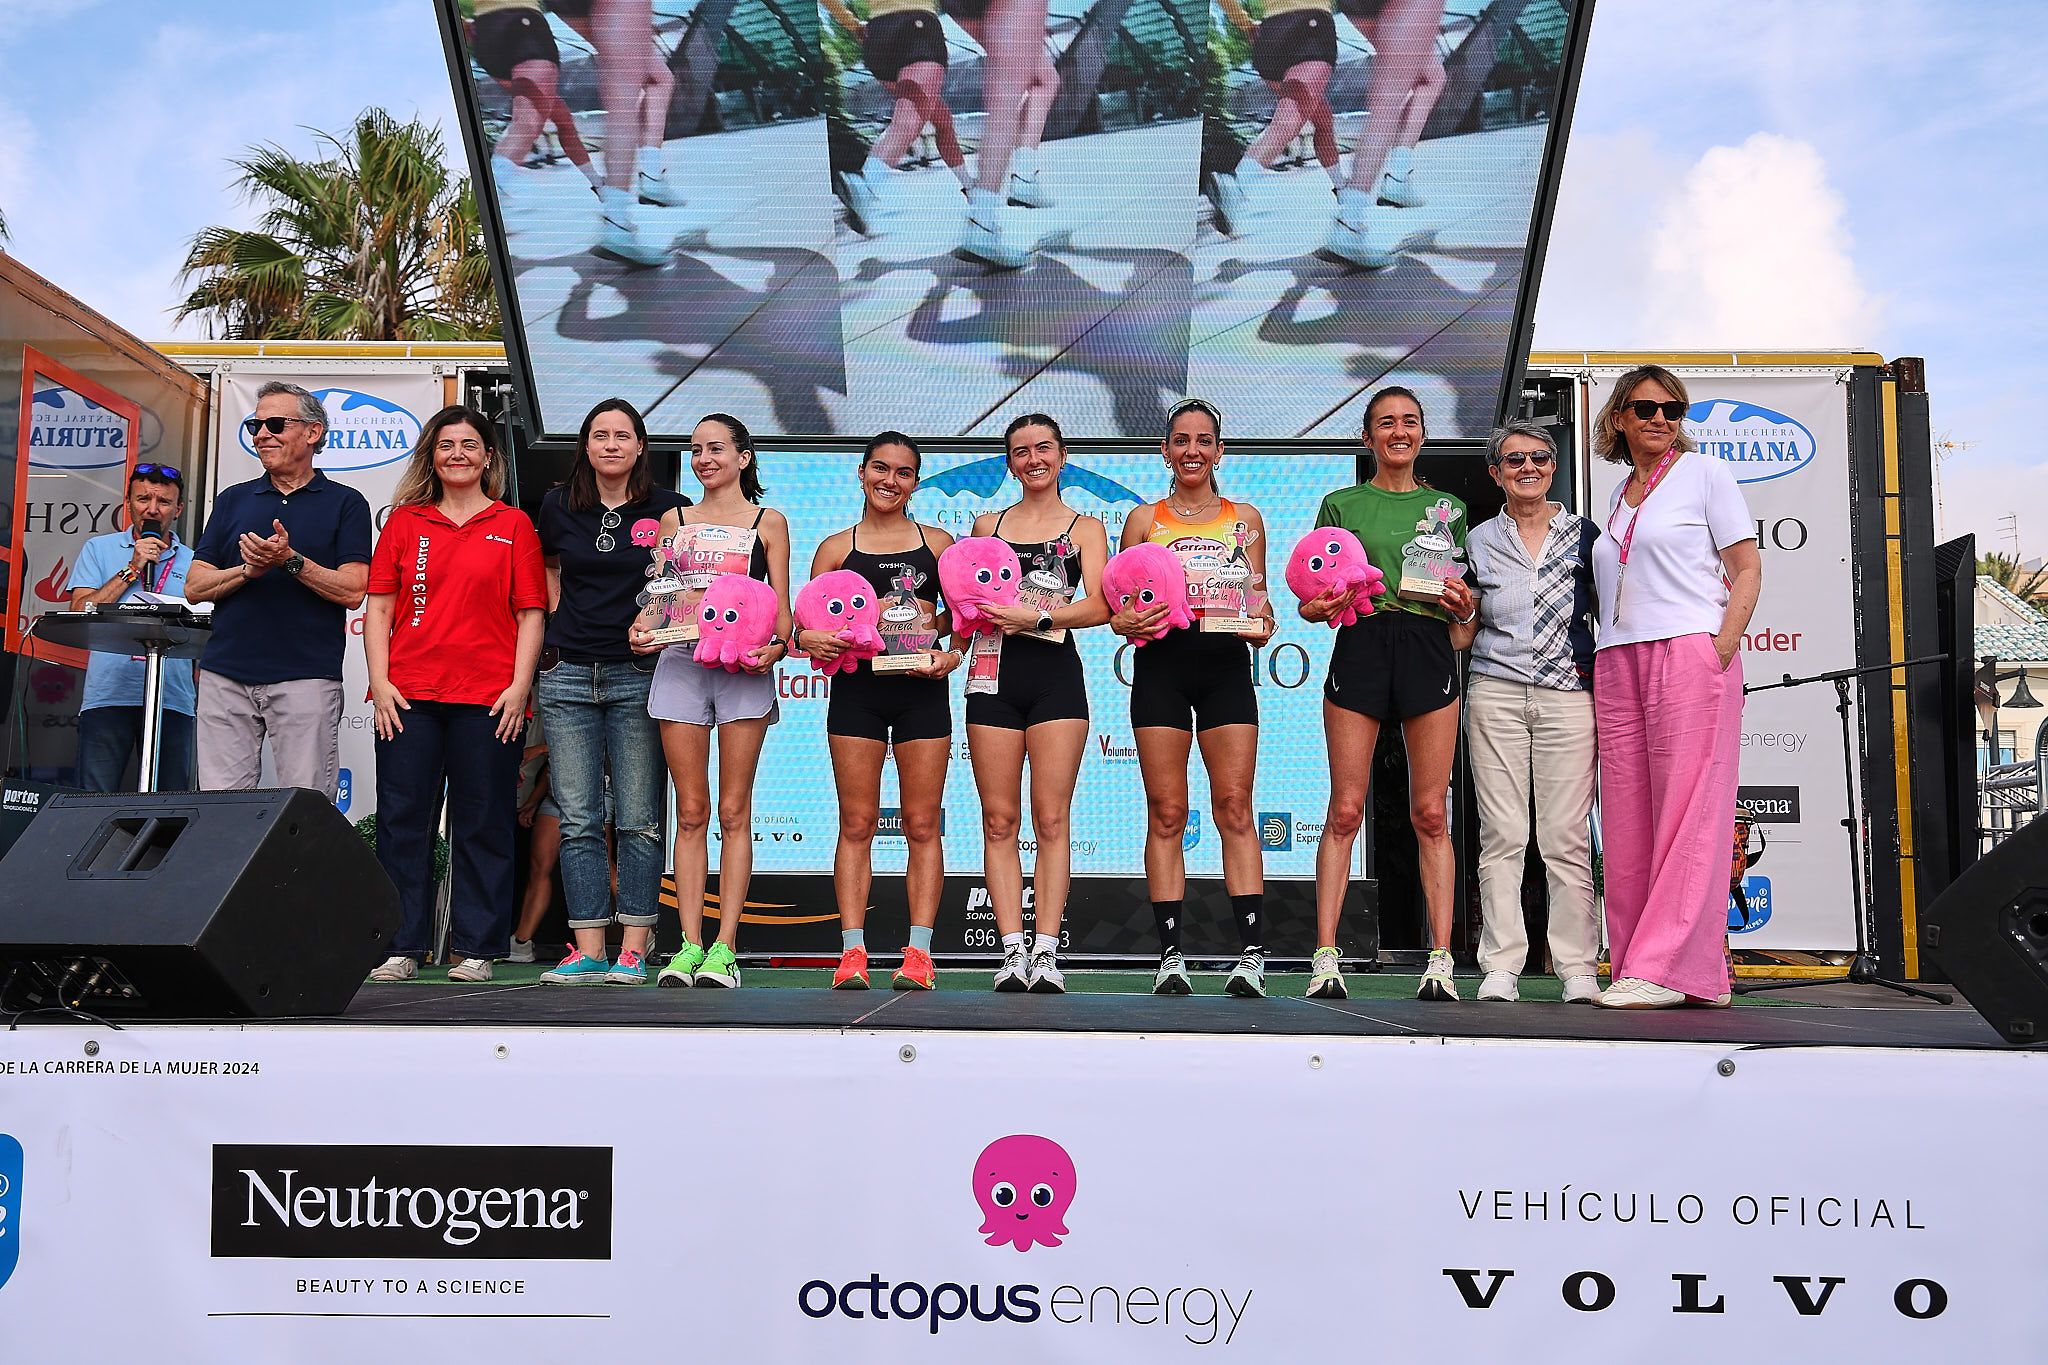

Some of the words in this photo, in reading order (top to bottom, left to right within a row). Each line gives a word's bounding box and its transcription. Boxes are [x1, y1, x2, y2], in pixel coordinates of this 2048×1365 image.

[345, 416, 404, 425] LECHERA
[326, 429, 409, 450] RIANA
[1688, 428, 1729, 437] NTRAL
[1735, 428, 1796, 437] LECHERA
[1697, 440, 1803, 462] URIANA
[415, 535, 430, 571] correr
[694, 551, 725, 563] 016
[1405, 546, 1443, 560] Carrera
[1408, 559, 1417, 567] de
[1419, 560, 1426, 569] la
[1018, 580, 1055, 599] Carrera
[1206, 577, 1244, 590] Carrera
[1019, 595, 1029, 604] de
[1029, 598, 1037, 606] la
[646, 608, 654, 617] de
[656, 607, 664, 615] la
[877, 621, 913, 632] Carrera
[1740, 733, 1807, 753] energy
[3, 789, 40, 805] portos
[764, 816, 800, 824] OFICIAL
[1070, 840, 1098, 856] ergy
[964, 928, 996, 947] 696
[20, 1061, 39, 1075] LA
[43, 1061, 116, 1075] CARRERA
[120, 1062, 139, 1075] DE
[144, 1062, 163, 1075] LA
[167, 1062, 219, 1075] MUJER
[222, 1062, 260, 1075] 2024
[1458, 1184, 1706, 1226] VEHÍCULO
[1731, 1195, 1926, 1231] OFICIAL
[296, 1278, 375, 1294] BEAUTY
[382, 1279, 409, 1294] TO
[416, 1280, 429, 1294] A
[436, 1280, 526, 1295] SCIENCE
[1441, 1268, 1950, 1320] VOLVO
[798, 1272, 1041, 1335] octopus
[1050, 1284, 1253, 1345] energy
